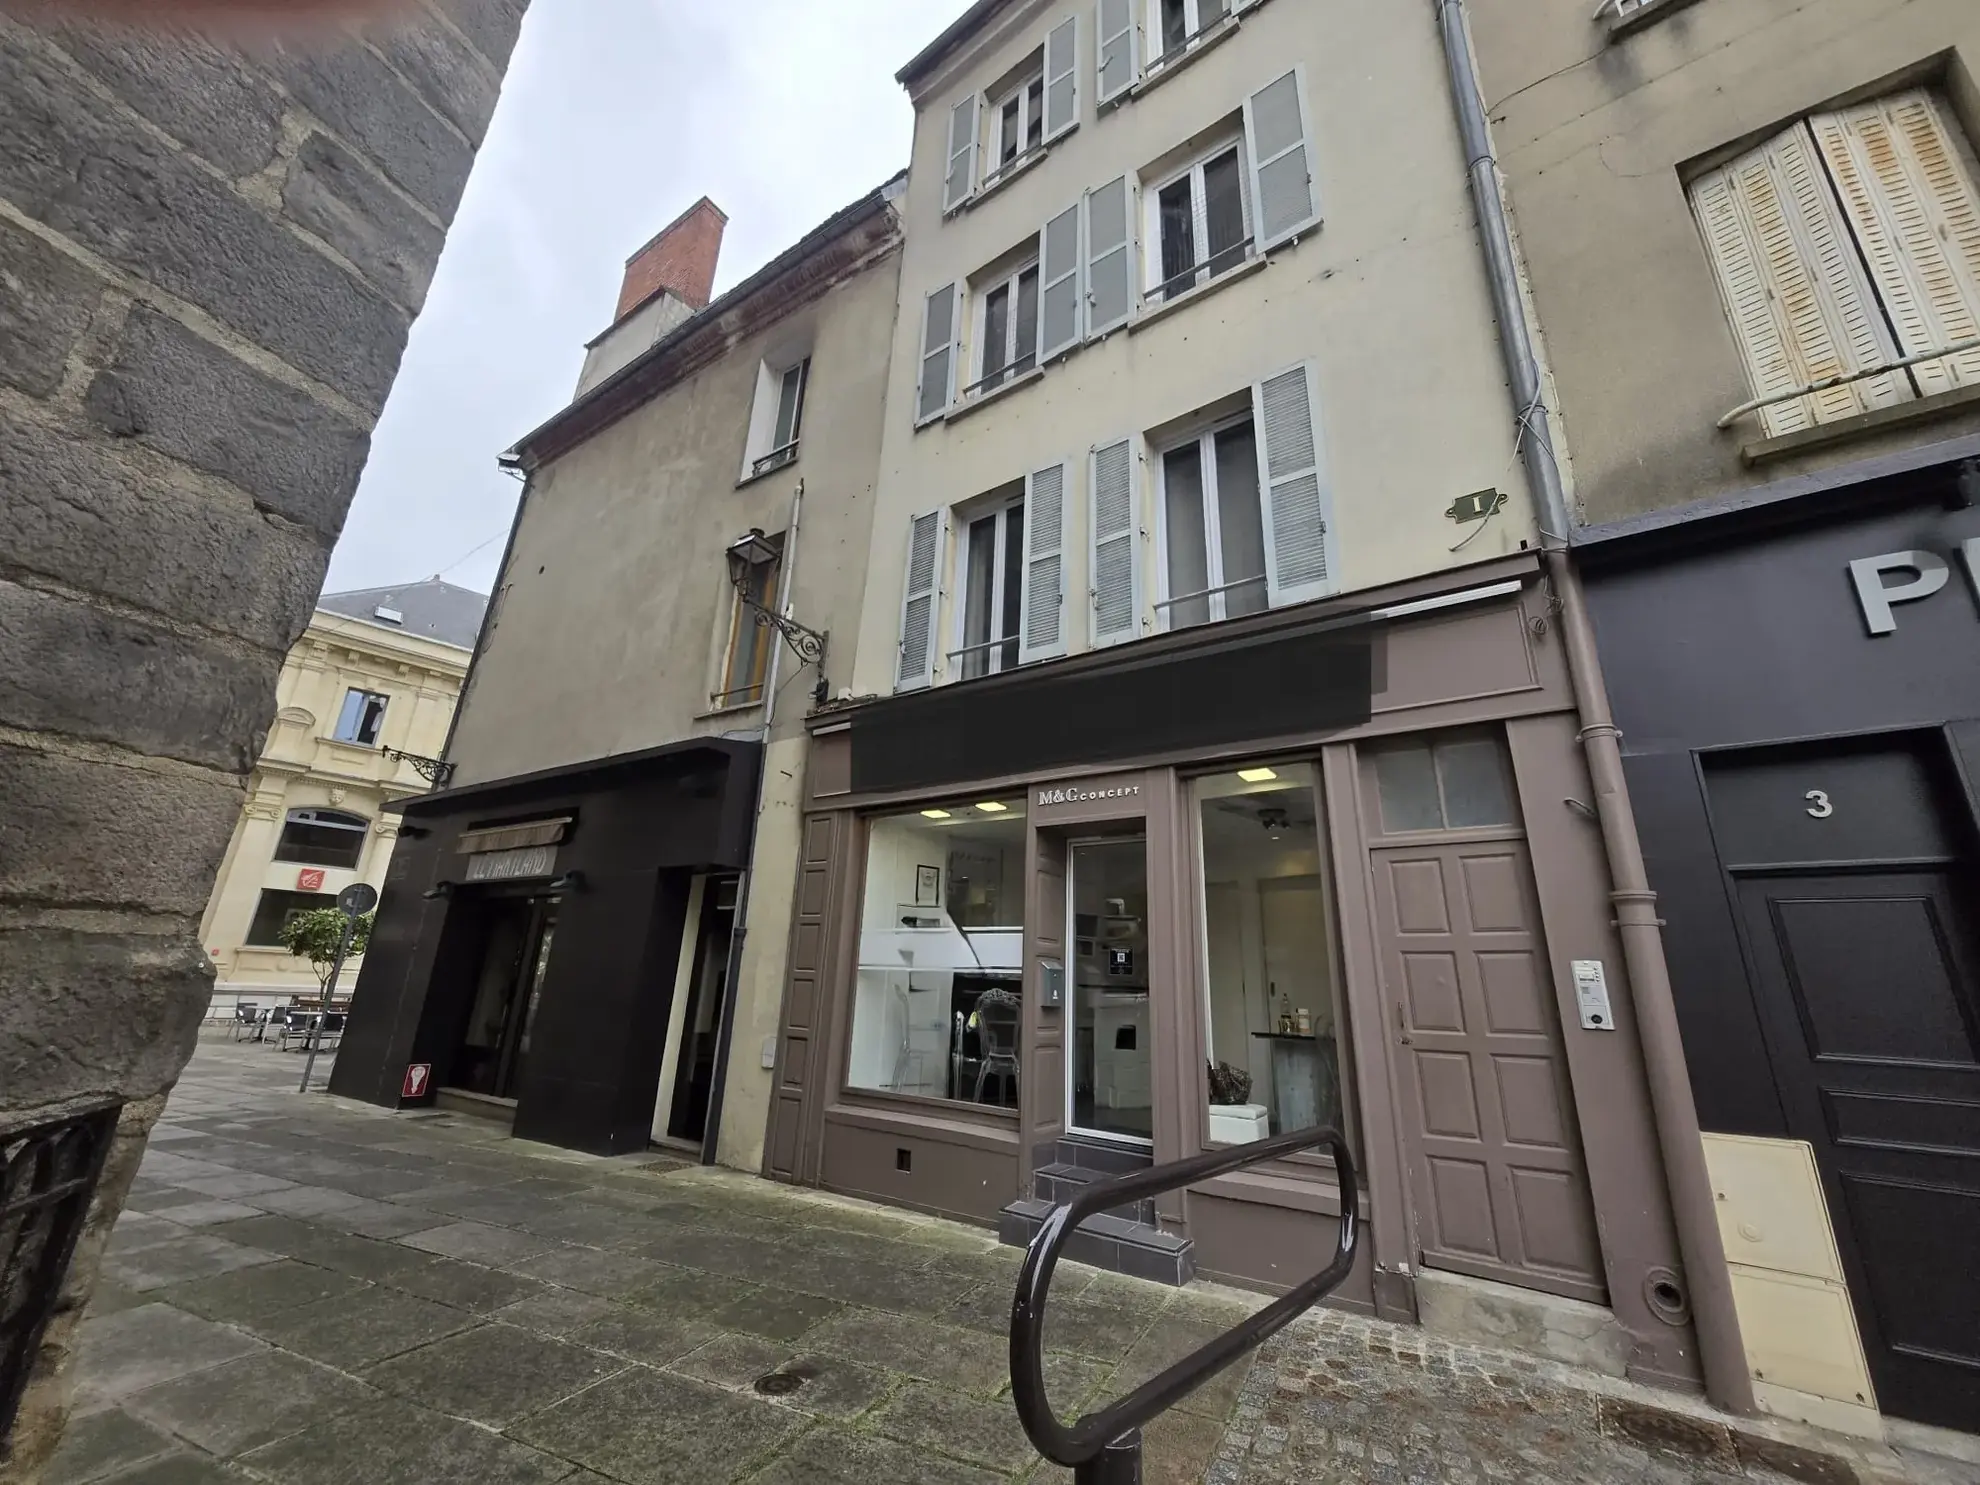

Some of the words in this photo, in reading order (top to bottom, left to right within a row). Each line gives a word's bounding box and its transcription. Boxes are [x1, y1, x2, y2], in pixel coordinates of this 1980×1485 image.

[1848, 536, 1980, 635] P
[1037, 787, 1078, 806] M&G
[1079, 786, 1140, 801] CONCEPT
[1805, 790, 1833, 818] 3
